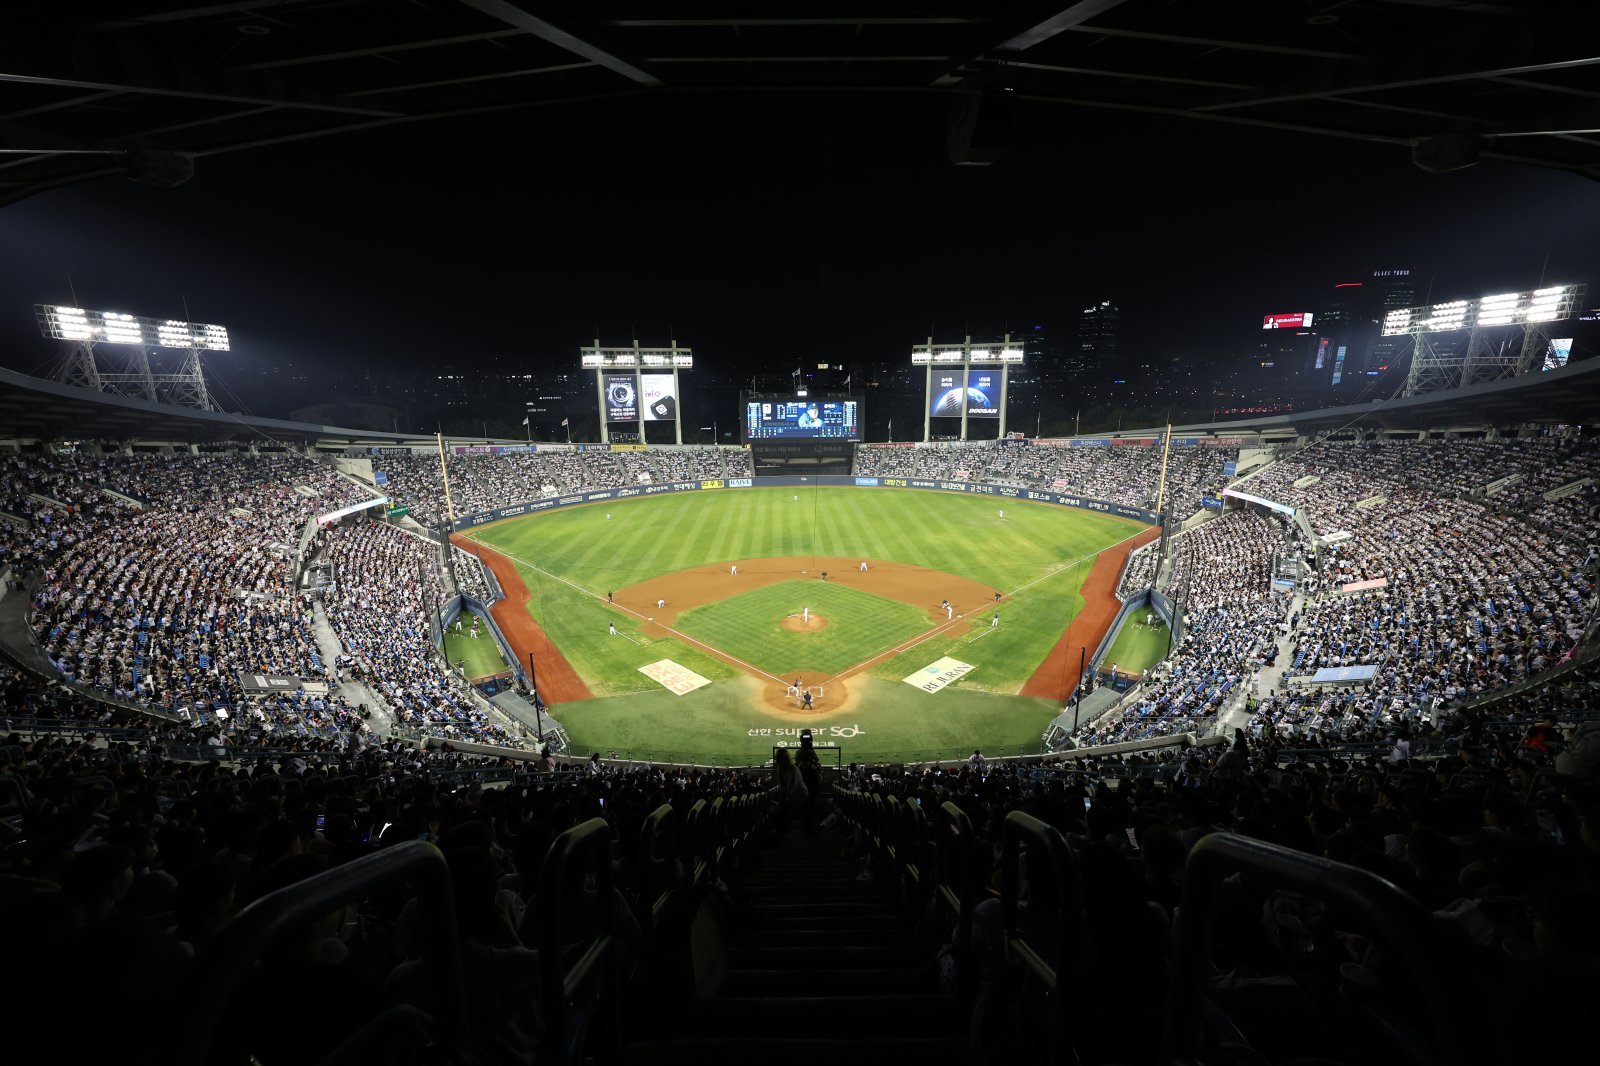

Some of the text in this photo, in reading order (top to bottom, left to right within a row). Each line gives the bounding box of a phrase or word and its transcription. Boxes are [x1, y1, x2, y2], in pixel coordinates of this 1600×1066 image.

[673, 483, 696, 491] 현대해상
[922, 664, 970, 691] REJURAN
[747, 728, 772, 736] 신한
[830, 724, 866, 738] SOL
